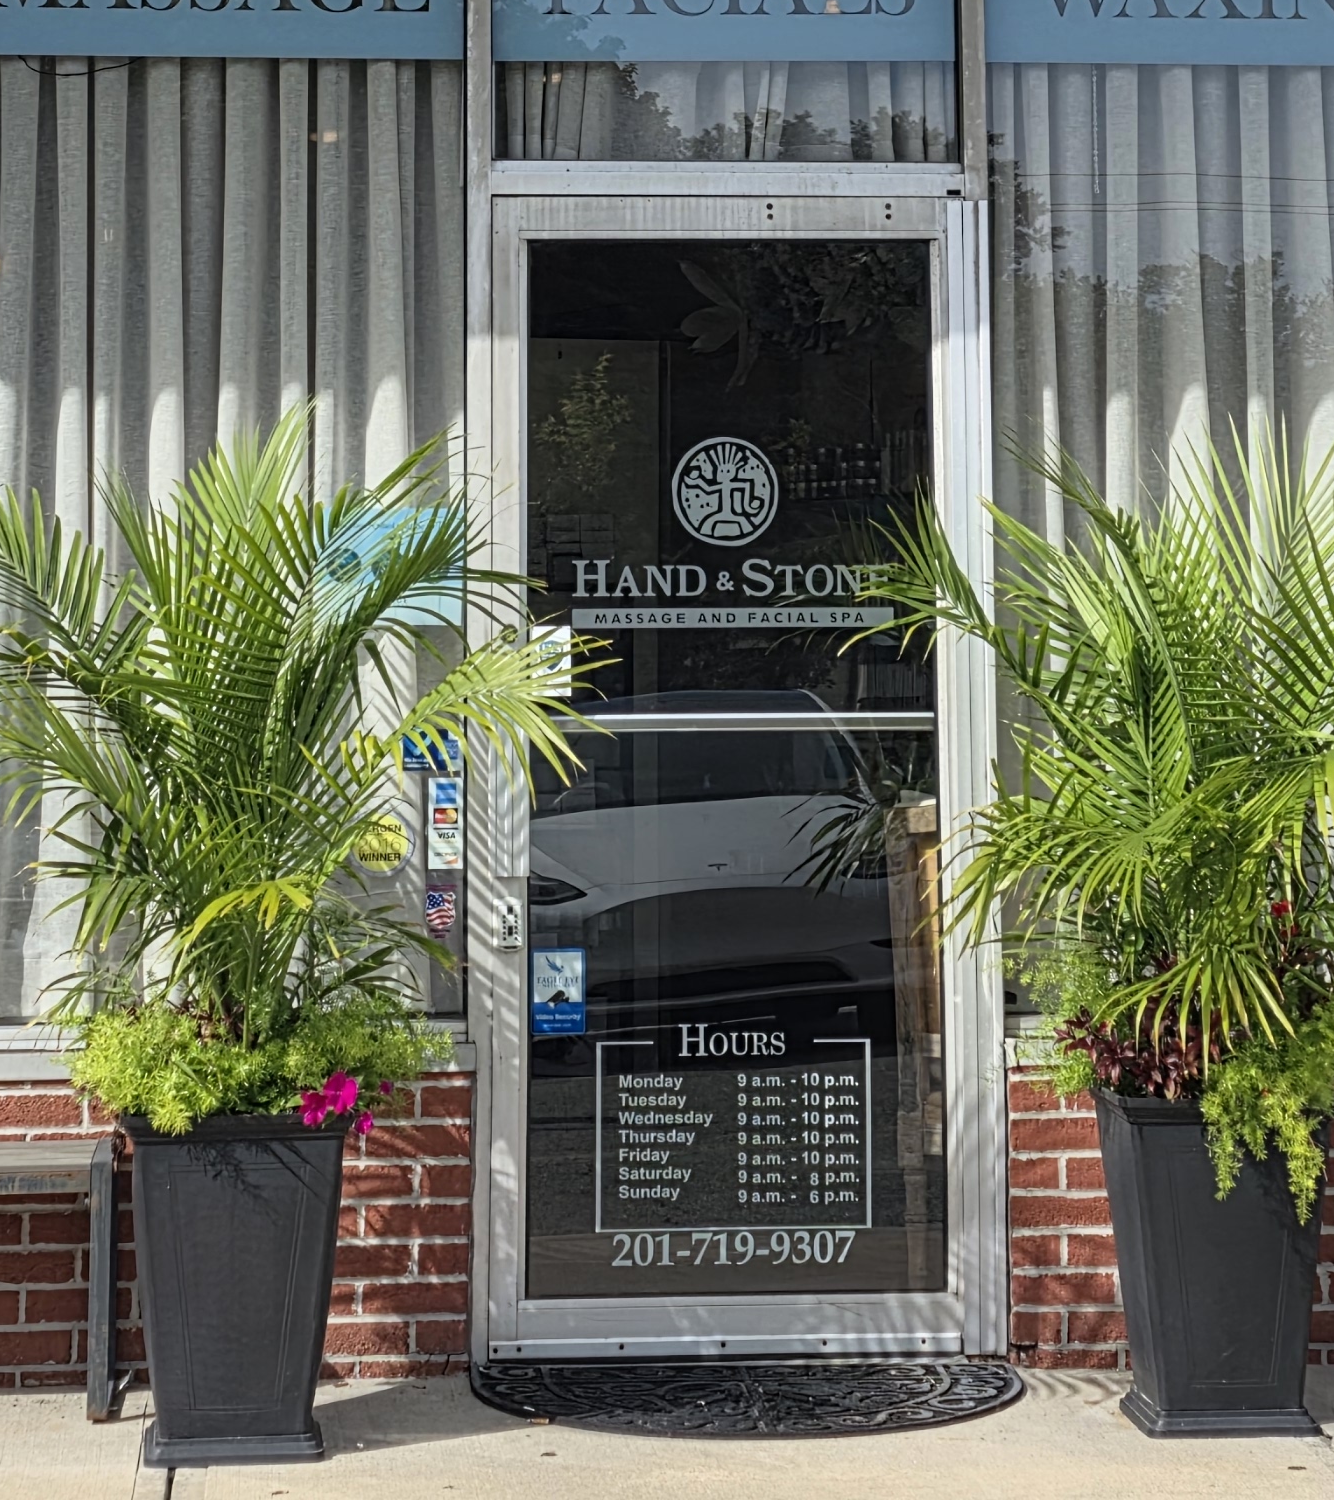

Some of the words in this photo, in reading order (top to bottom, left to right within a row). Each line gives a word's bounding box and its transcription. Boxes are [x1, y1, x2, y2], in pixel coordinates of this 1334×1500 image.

[571, 559, 707, 598] HAND
[716, 570, 735, 591] &
[594, 612, 686, 624] MASSAGE
[697, 612, 736, 624] AND
[747, 611, 820, 624] FACIAL
[830, 611, 865, 623] SPA
[436, 831, 456, 839] VISA
[358, 852, 402, 862] WINNER
[677, 1023, 786, 1057] HOURS
[618, 1074, 684, 1090] Monday
[737, 1074, 747, 1087] 9
[752, 1077, 786, 1087] a.m.
[801, 1073, 819, 1086] 10
[824, 1076, 859, 1088] p.m.
[618, 1093, 687, 1108] Tuesday
[737, 1094, 747, 1106] 9
[752, 1097, 786, 1107] a.m.
[801, 1093, 819, 1106] 10
[824, 1095, 859, 1108] p.m.
[618, 1111, 714, 1127] Wednesday
[737, 1113, 747, 1125] 9
[752, 1115, 786, 1125] a.m.
[801, 1112, 819, 1125] 10
[824, 1115, 859, 1127] p.m.
[618, 1130, 696, 1145] Thursday
[737, 1132, 747, 1145] 9
[752, 1135, 786, 1145] a.m.
[801, 1131, 819, 1144] 10
[824, 1134, 859, 1146] p.m.
[618, 1149, 670, 1164] Friday
[737, 1152, 747, 1165] 9
[752, 1154, 786, 1165] a.m.
[801, 1151, 819, 1164] 10
[824, 1153, 859, 1166] p.m.
[618, 1167, 692, 1182] Saturday
[737, 1171, 747, 1183] 9
[752, 1173, 786, 1183] a.m.
[810, 1173, 819, 1185] 8
[824, 1172, 859, 1185] p.m.
[618, 1185, 681, 1200] Sunday
[737, 1190, 747, 1203] 9
[752, 1192, 786, 1202] a.m.
[810, 1190, 819, 1203] 6
[824, 1192, 859, 1204] p.m.
[611, 1229, 856, 1267] 201-719-9307
